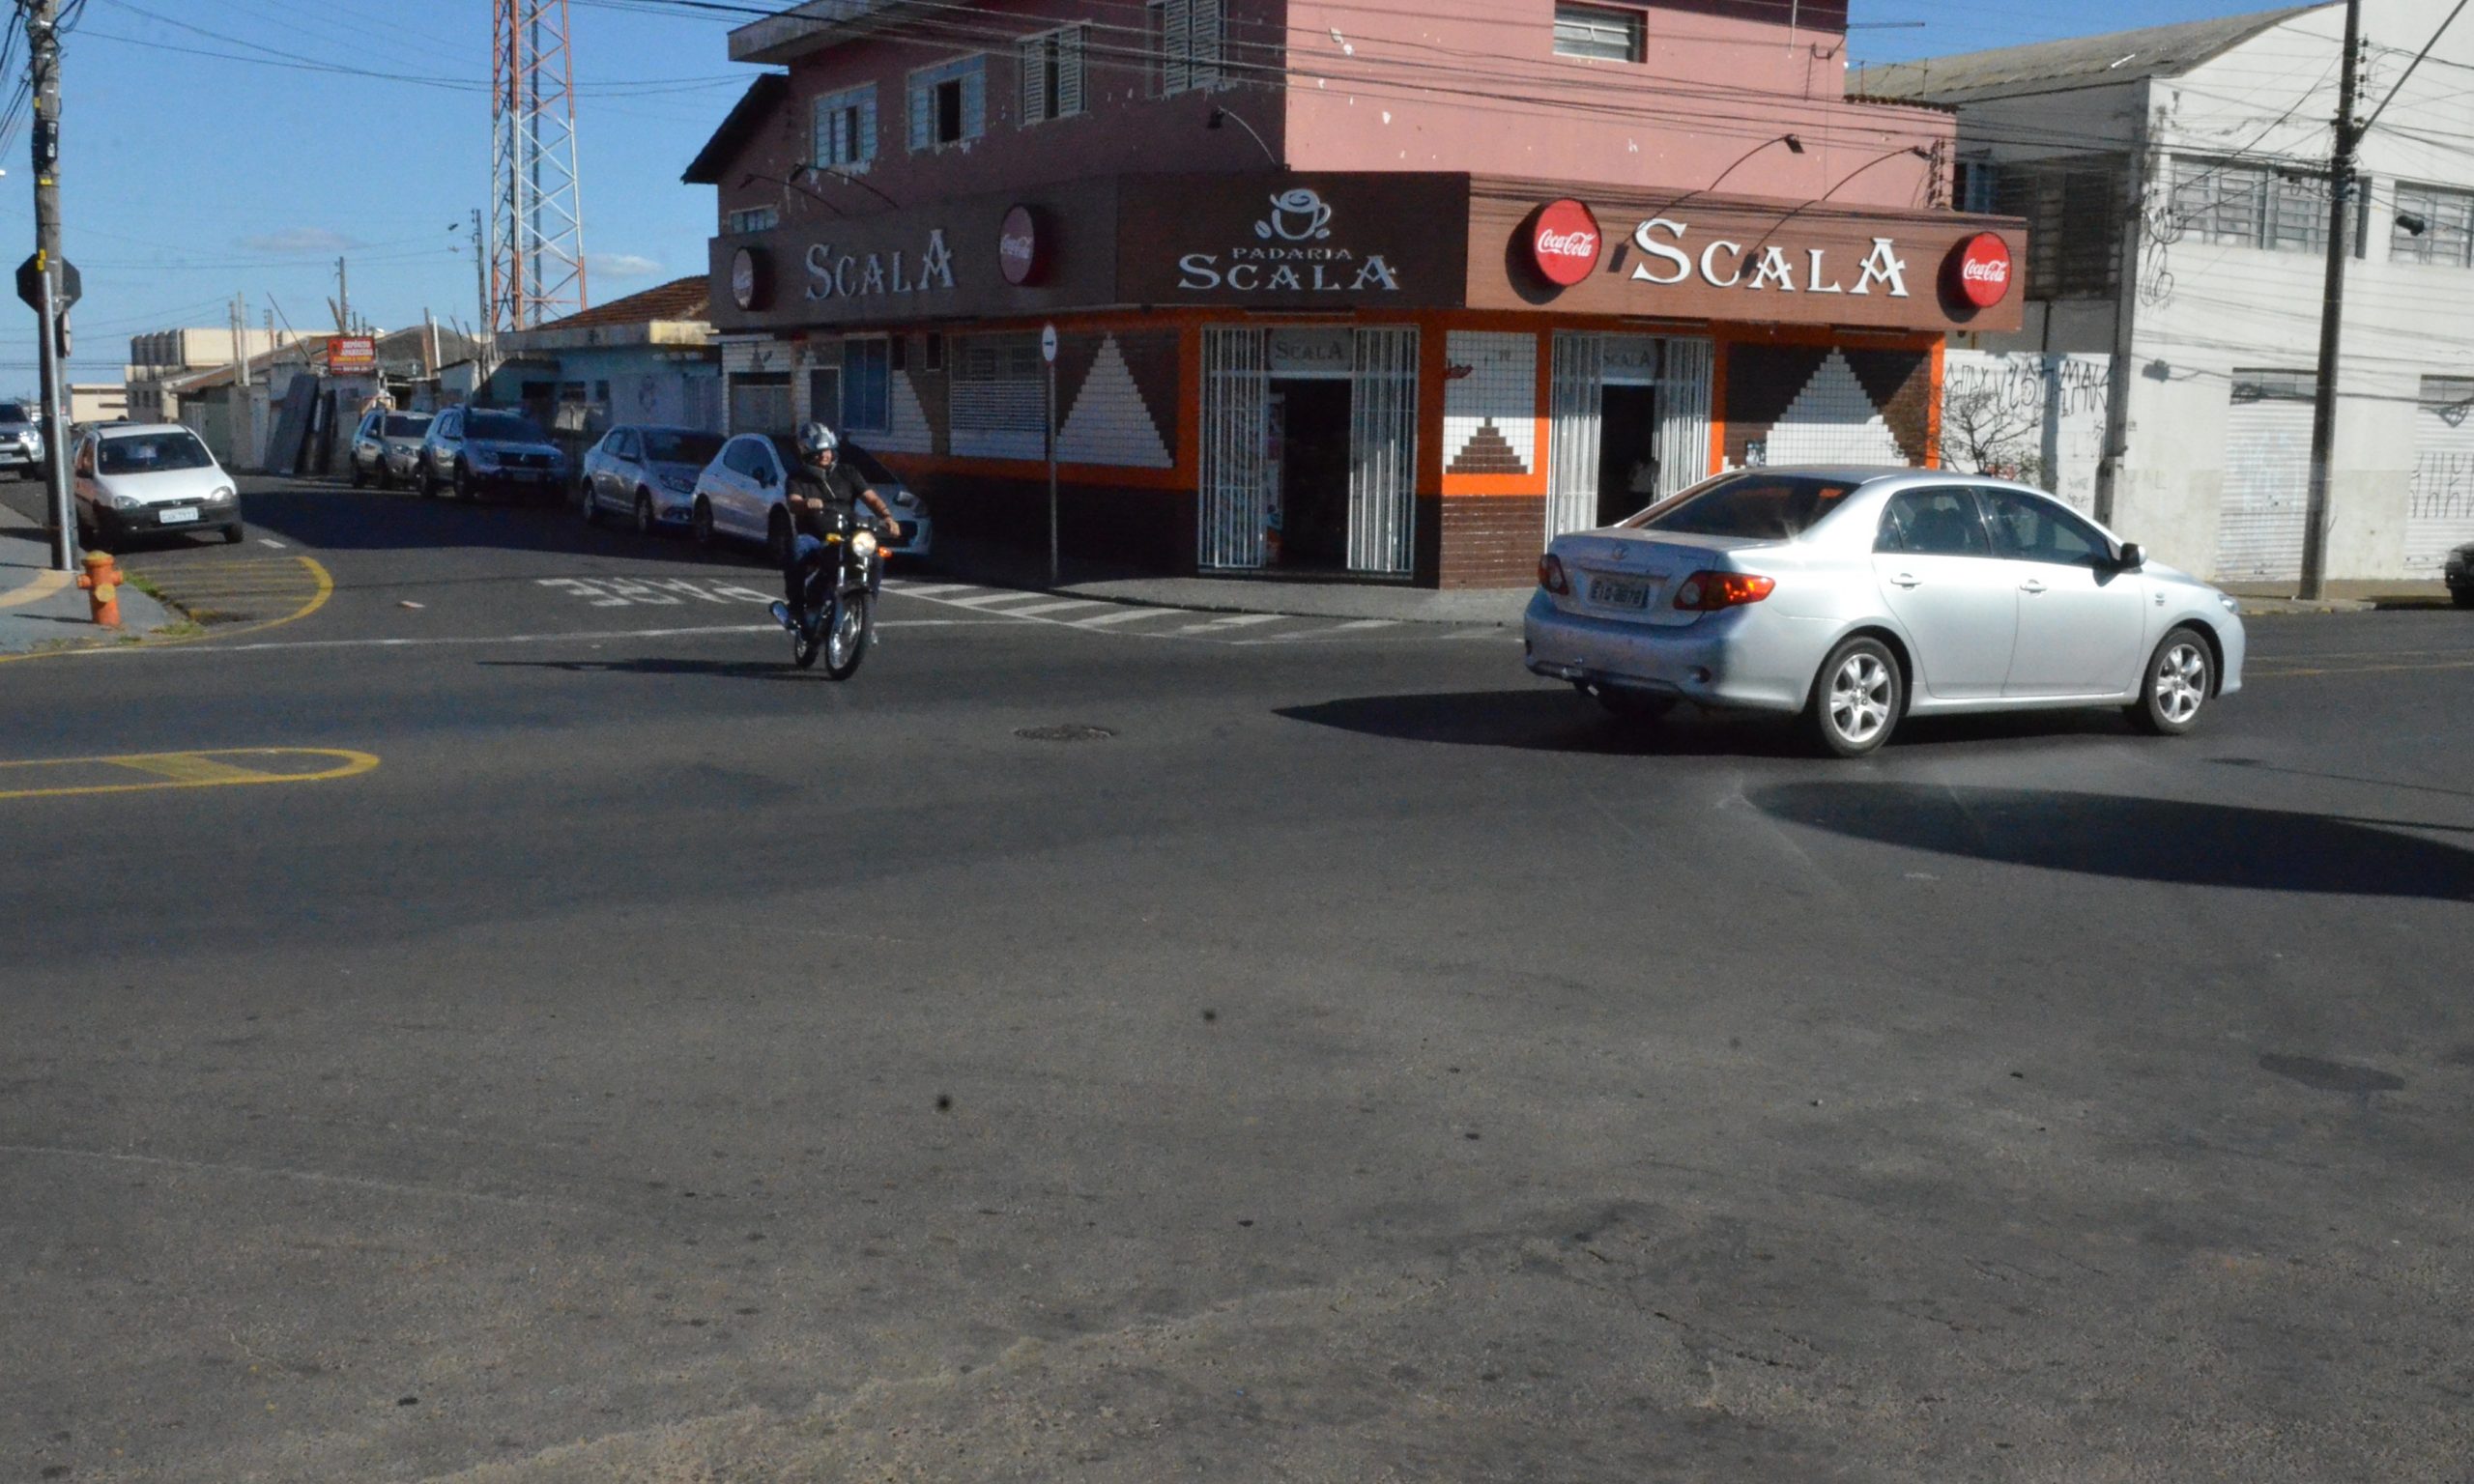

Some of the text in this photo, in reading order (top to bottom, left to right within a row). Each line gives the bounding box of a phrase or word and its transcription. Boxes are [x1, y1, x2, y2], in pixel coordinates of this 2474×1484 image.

[1232, 247, 1353, 260] PADARIA
[1538, 228, 1597, 257] Coca-Cola
[805, 229, 956, 301] SCALA
[1177, 253, 1399, 290] SCALA
[1631, 217, 1910, 298] SCALA
[1964, 258, 2009, 282] Coca-Cola
[1275, 341, 1343, 361] SCALA
[535, 578, 787, 607] PARE
